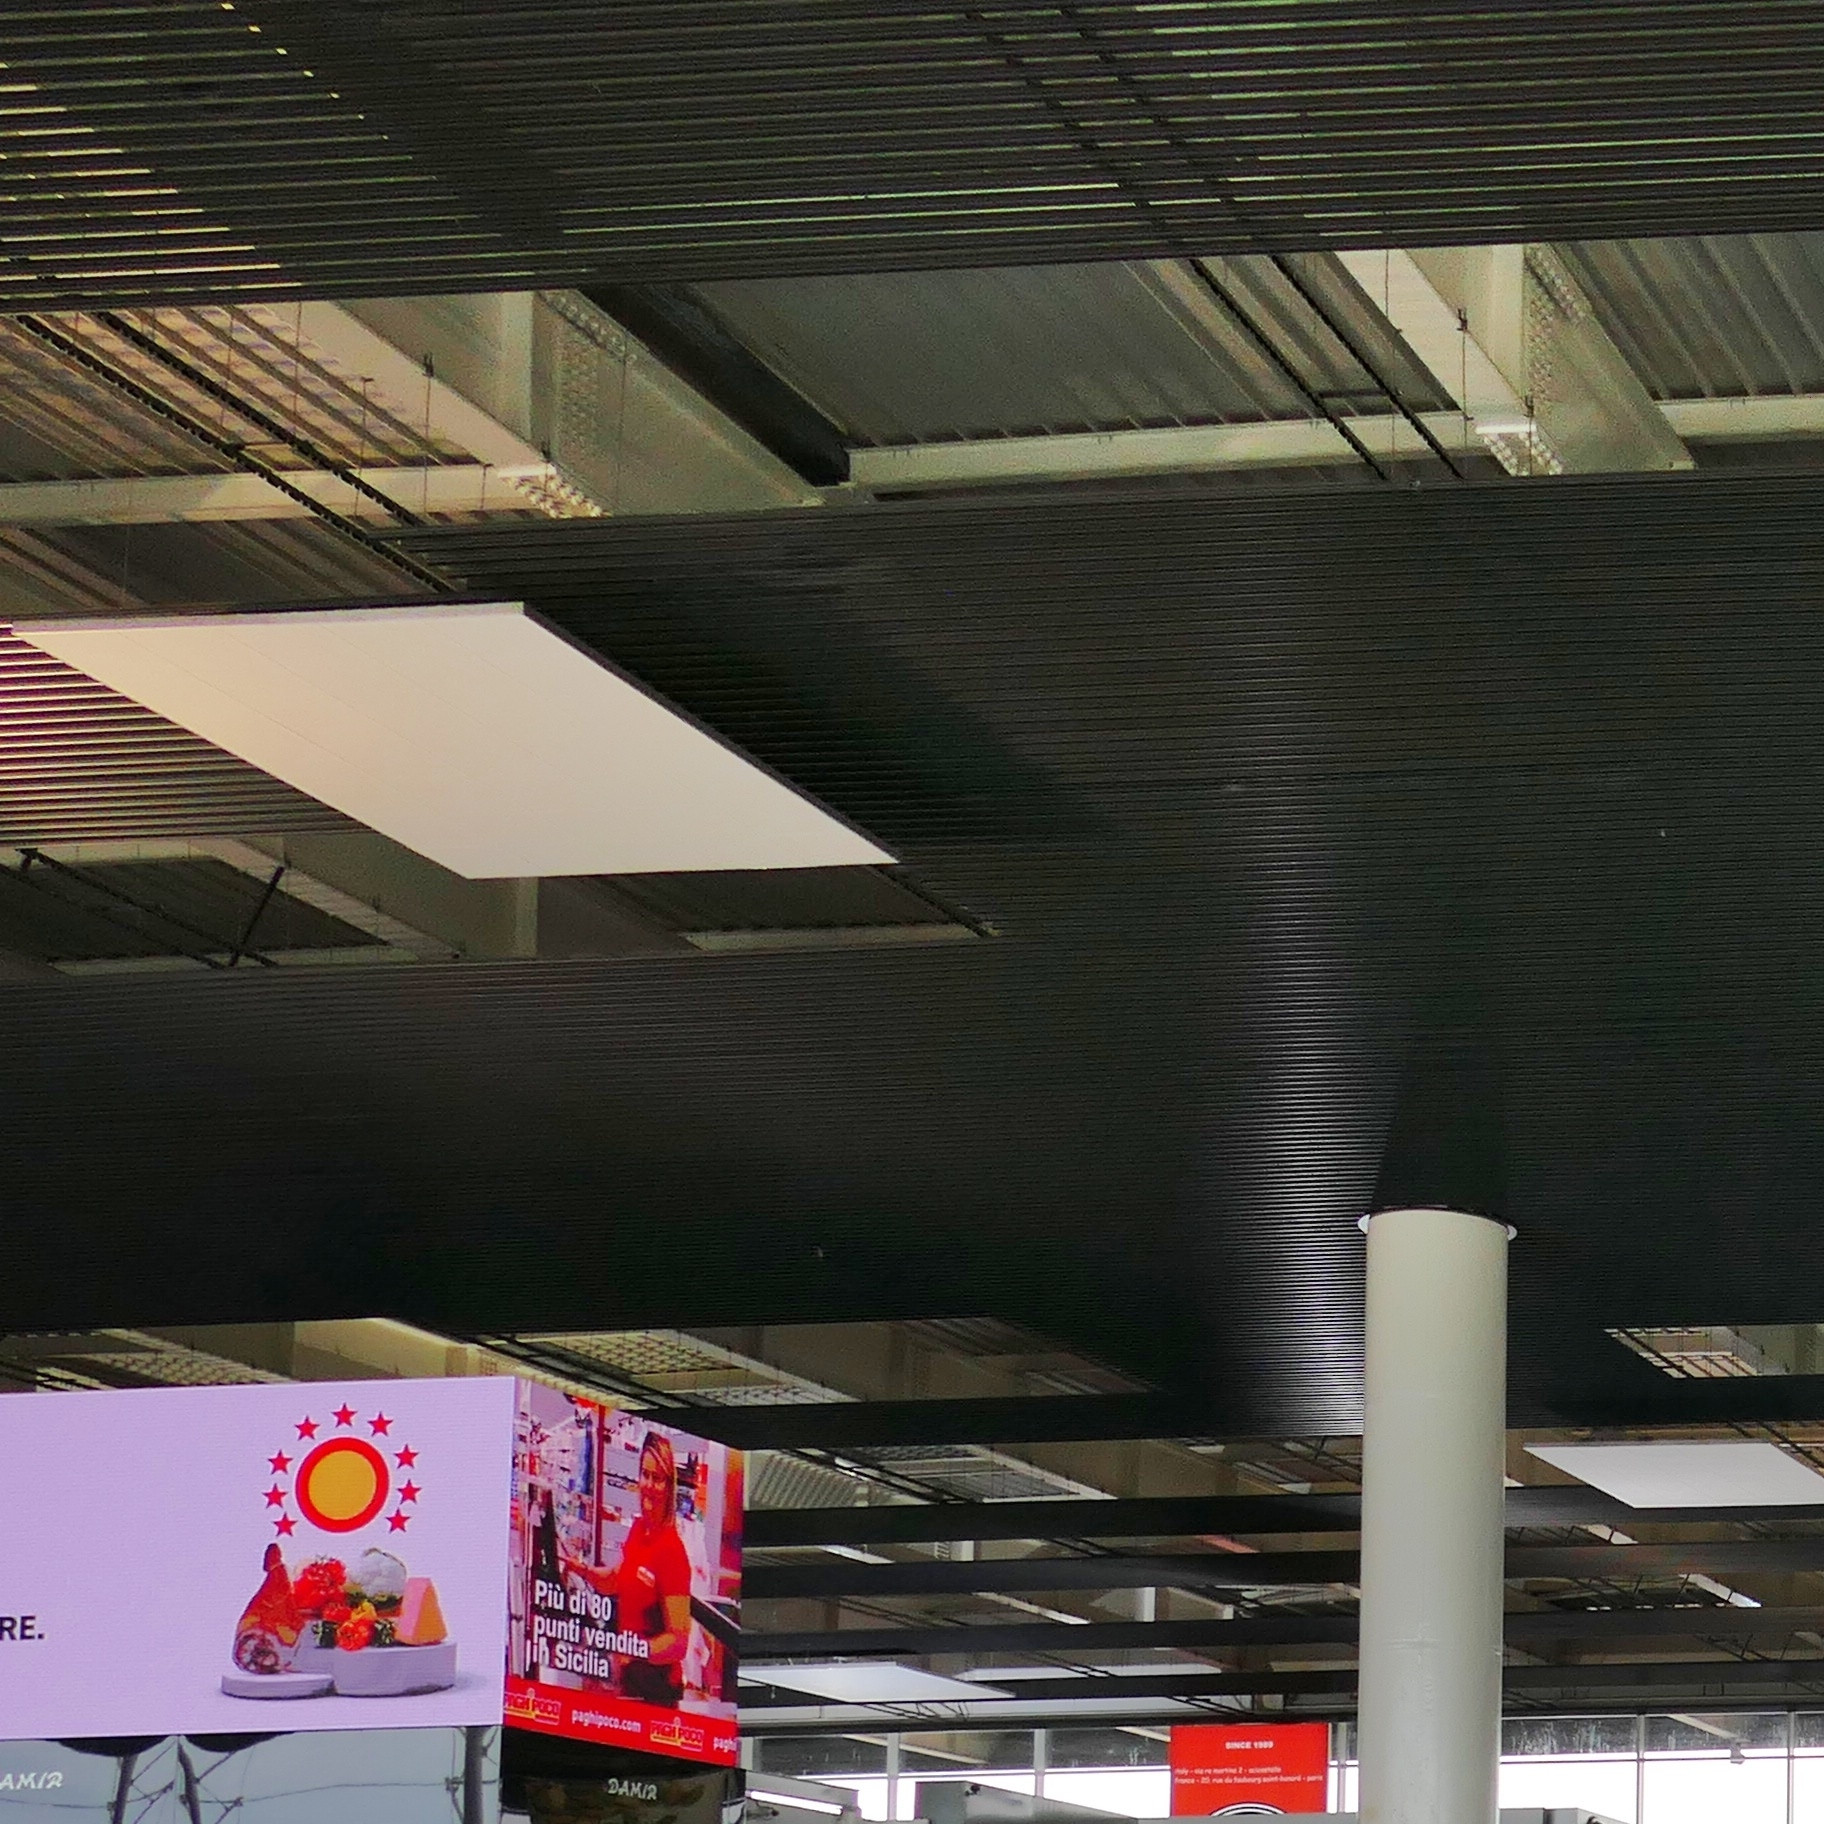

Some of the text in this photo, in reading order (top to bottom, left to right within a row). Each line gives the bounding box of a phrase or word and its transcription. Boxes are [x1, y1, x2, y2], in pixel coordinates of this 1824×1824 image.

[535, 1579, 612, 1621] Più di 80
[533, 1615, 649, 1658] punti vendita
[555, 1642, 610, 1678] Sicilia
[571, 1708, 642, 1733] paghipoco.com
[607, 1777, 658, 1801] DAMIR
